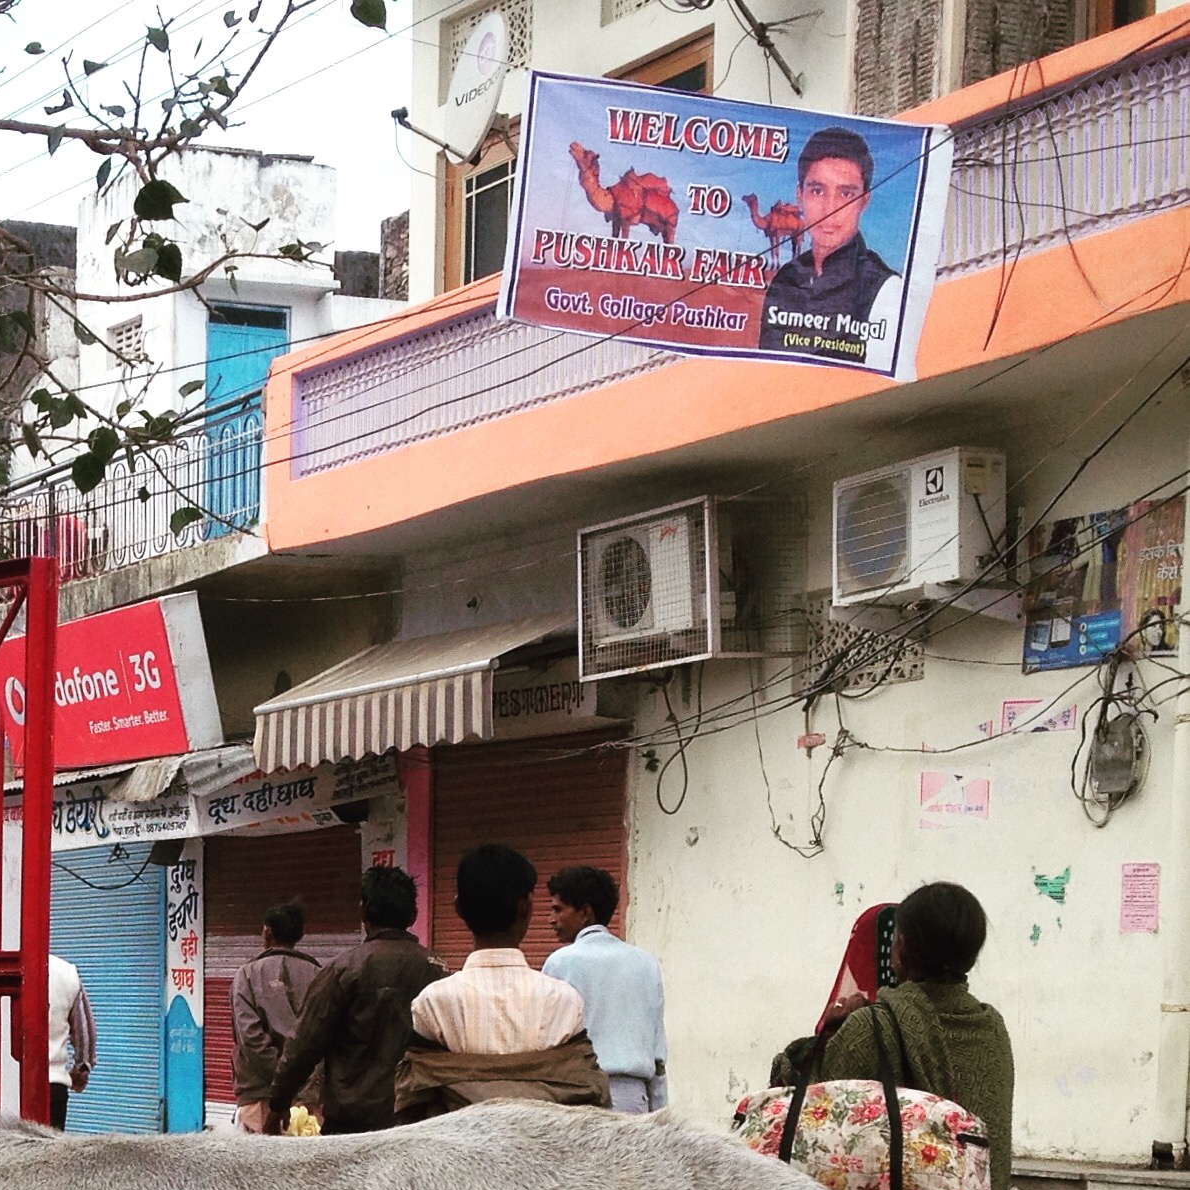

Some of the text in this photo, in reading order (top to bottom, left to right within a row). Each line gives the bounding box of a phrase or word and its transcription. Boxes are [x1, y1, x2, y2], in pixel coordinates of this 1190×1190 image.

[606, 106, 788, 163] WELCOME
[687, 183, 731, 217] TO
[531, 228, 767, 289] PUSHKAR FAIR
[545, 287, 748, 332] Govt. Collage Pushkar
[767, 306, 887, 341] Sameer Mugal
[783, 333, 866, 357] (Vice President)
[918, 493, 950, 508] Electrolux
[54, 650, 161, 707] dafone 3G
[88, 709, 170, 735] Faster. Smarter. Better.
[180, 929, 199, 964] दही
